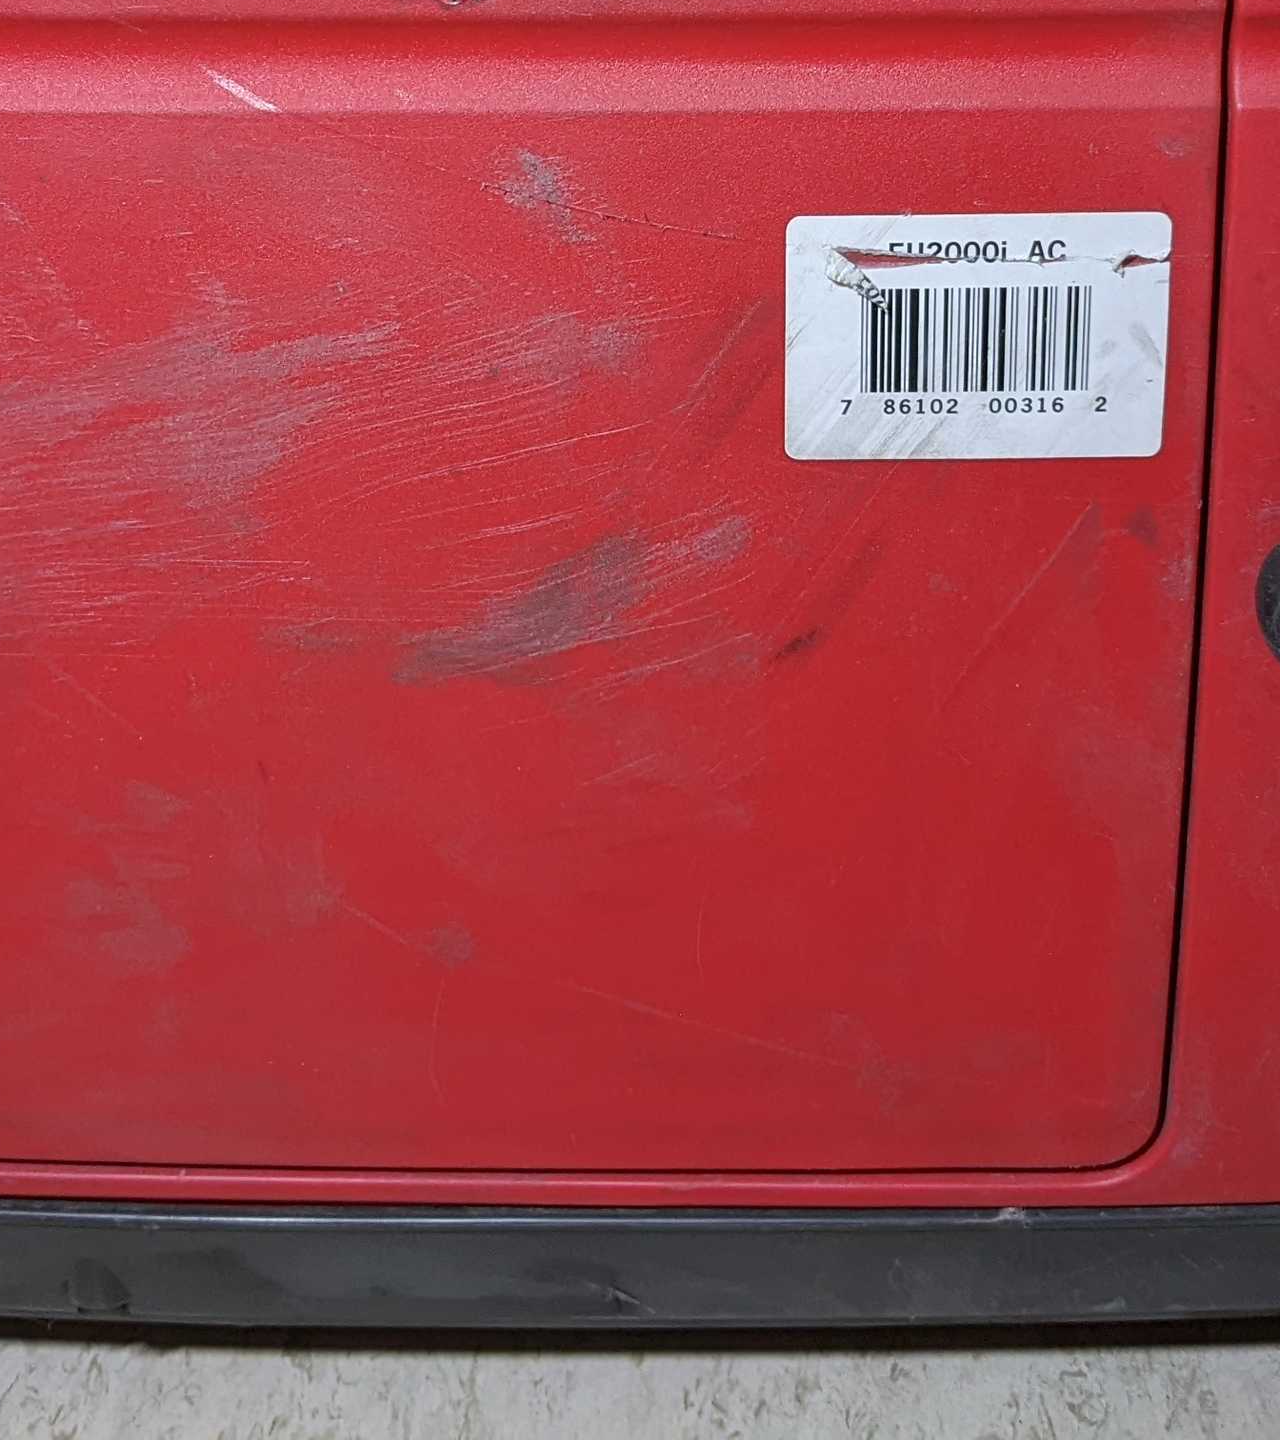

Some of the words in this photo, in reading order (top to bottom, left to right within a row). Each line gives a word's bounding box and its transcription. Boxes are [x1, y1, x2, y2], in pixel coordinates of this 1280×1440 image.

[1028, 239, 1067, 261] AC
[840, 401, 852, 416] 7
[883, 399, 959, 415] 86102
[989, 397, 1064, 414] 00316
[1095, 396, 1107, 412] 2
